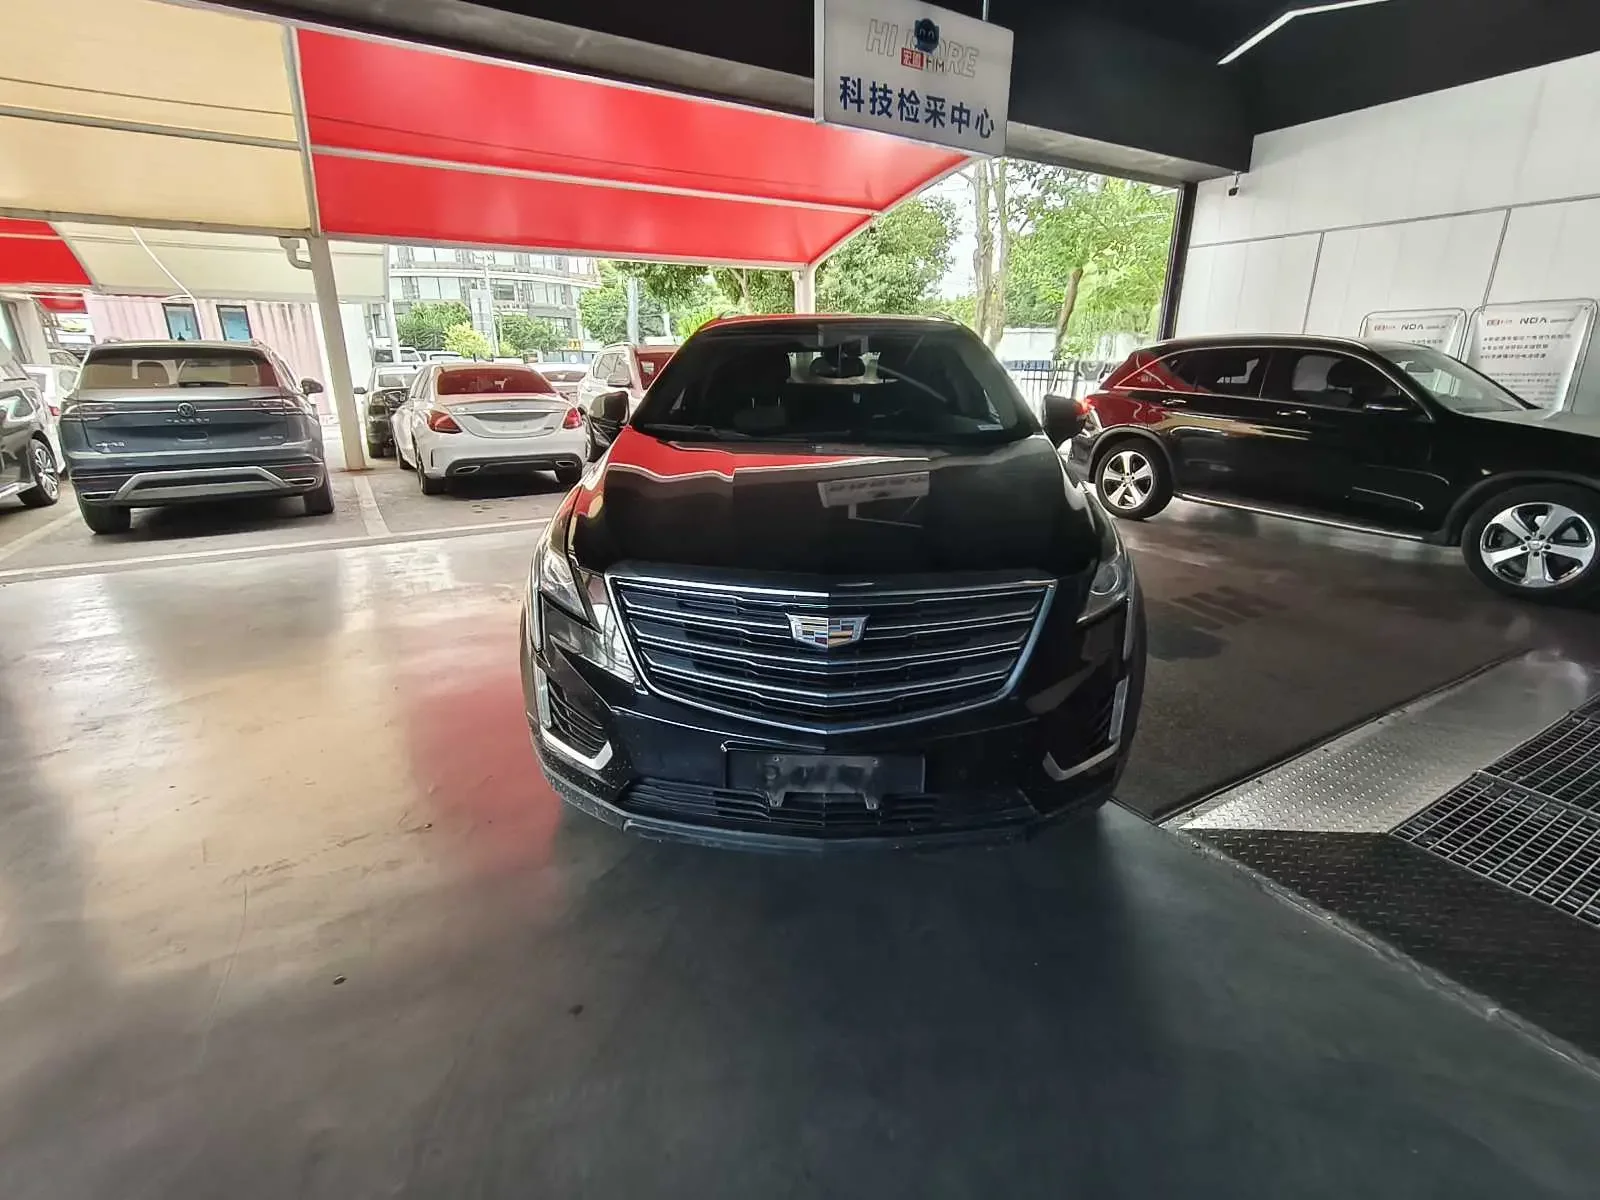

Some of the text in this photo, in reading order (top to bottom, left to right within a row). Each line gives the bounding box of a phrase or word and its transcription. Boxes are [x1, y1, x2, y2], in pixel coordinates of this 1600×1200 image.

[866, 18, 898, 57] HI
[839, 76, 995, 139] 科技检采中心
